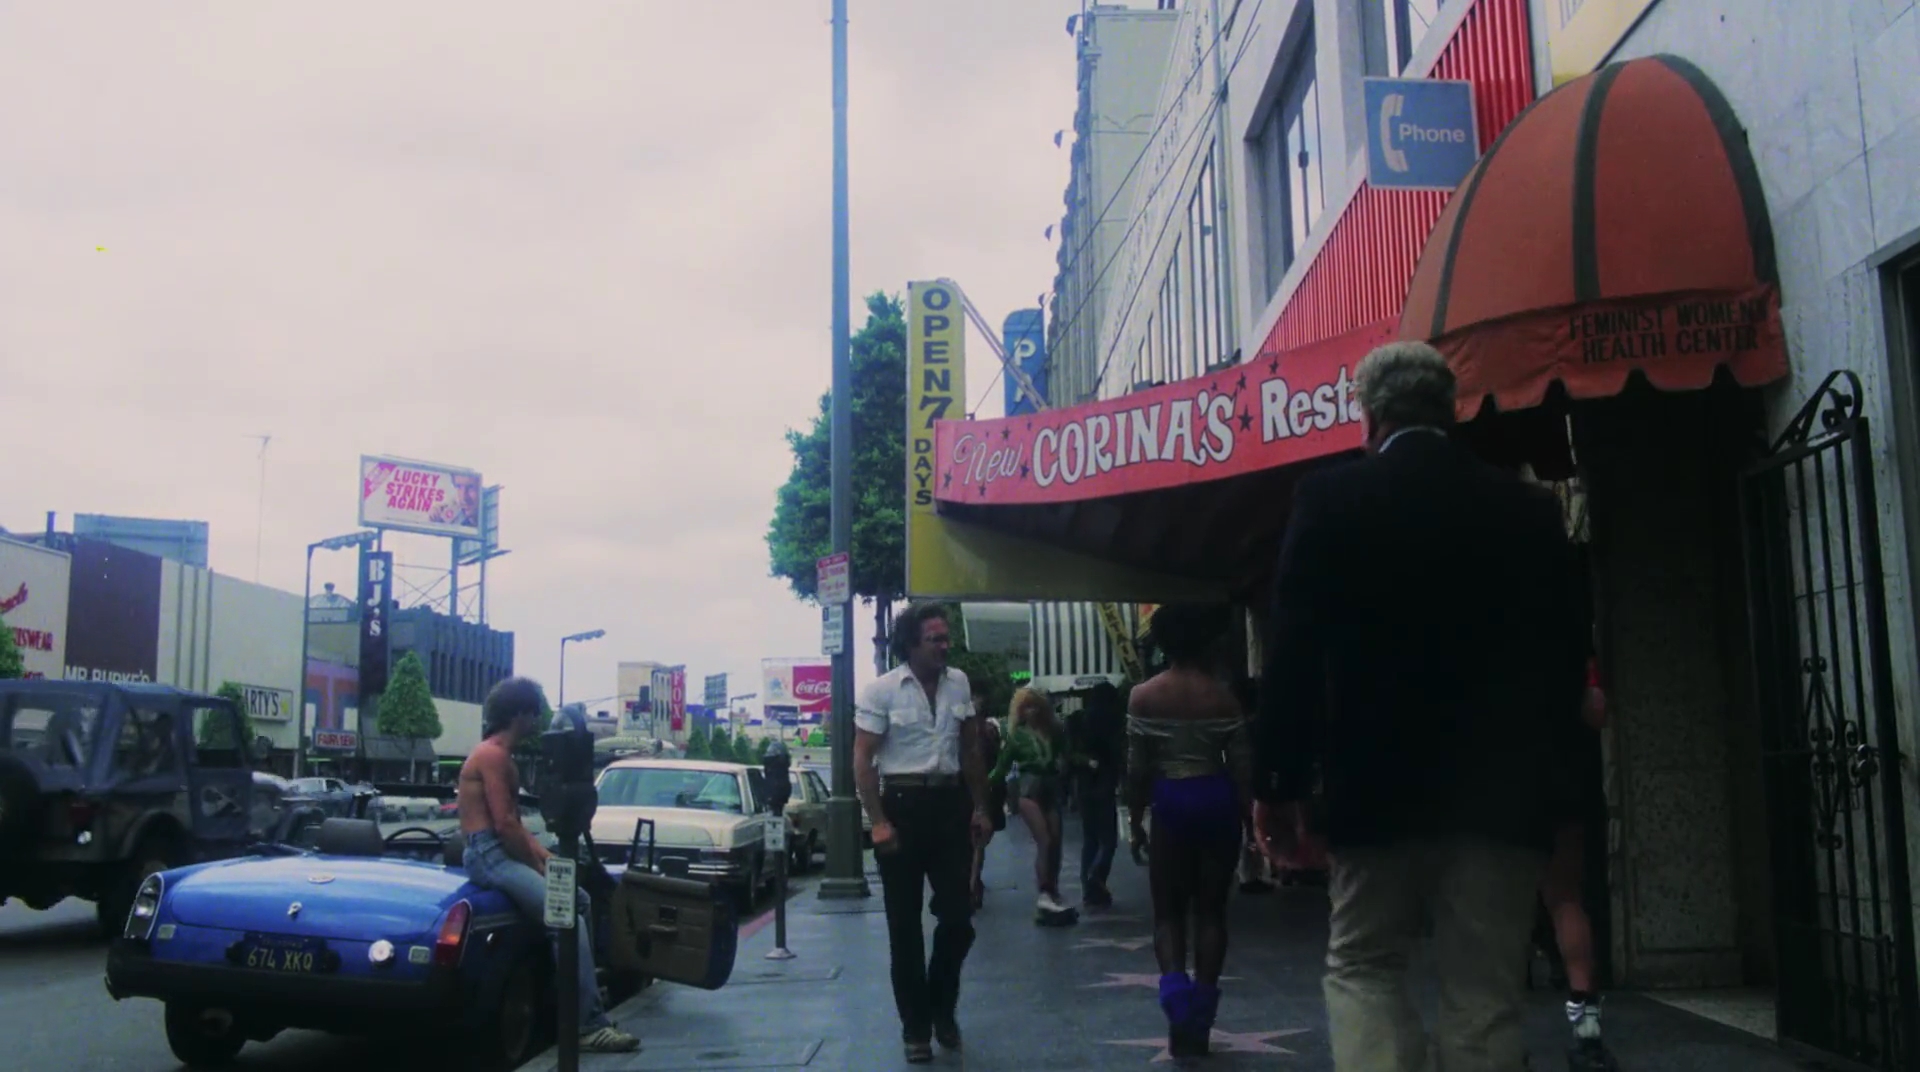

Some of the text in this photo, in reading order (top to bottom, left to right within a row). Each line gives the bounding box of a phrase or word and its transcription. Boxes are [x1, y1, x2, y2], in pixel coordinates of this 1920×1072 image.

[1399, 123, 1466, 143] Phone
[1568, 304, 1664, 340] FEMINIST
[1581, 324, 1759, 364] HEALTH CENTER
[914, 287, 953, 505] OPEN 7 DAYS
[953, 433, 1023, 486] New
[1033, 391, 1237, 488] CORINA'S
[386, 481, 445, 502] STRIKES
[394, 469, 440, 488] LUCKY
[387, 495, 434, 512] AGAIN
[672, 672, 682, 719] FOX
[247, 946, 276, 969] 674
